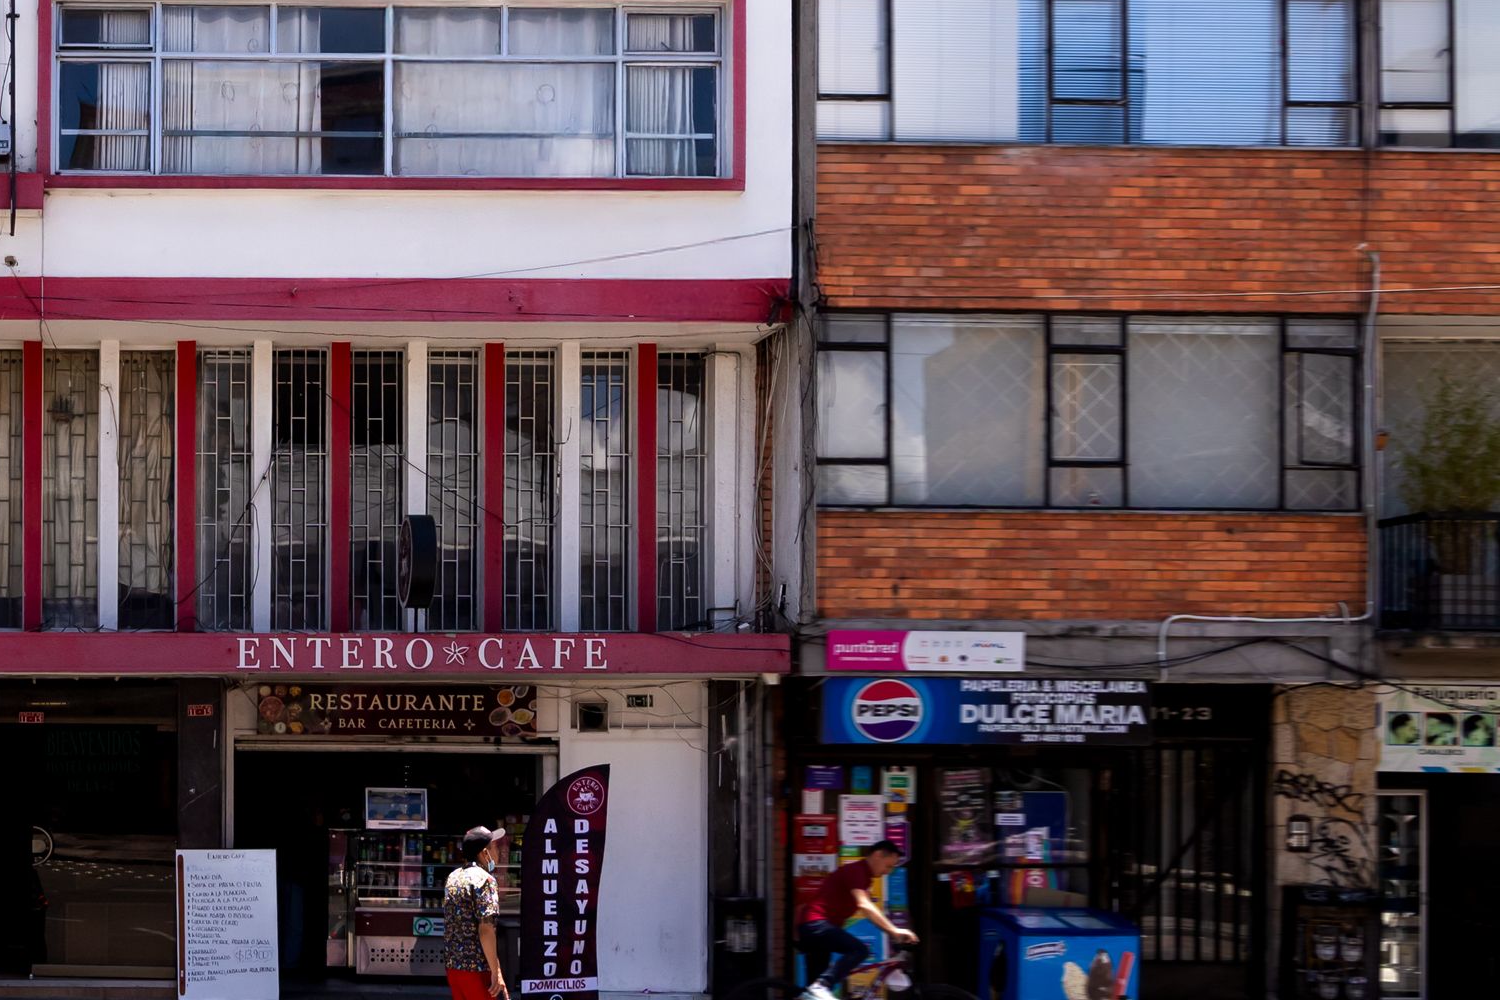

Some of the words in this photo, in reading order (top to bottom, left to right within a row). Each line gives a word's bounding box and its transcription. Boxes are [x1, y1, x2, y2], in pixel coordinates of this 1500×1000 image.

[236, 637, 434, 669] ENTERO
[478, 637, 608, 669] CAFE
[960, 680, 1038, 691] PAPELERIA
[1054, 680, 1148, 692] MISCELANEA
[309, 692, 485, 712] RESTAURANTE
[1010, 693, 1097, 704] FOTOCOPIAS
[857, 703, 920, 717] PEPSI
[959, 704, 1051, 723] DULCE
[1053, 705, 1148, 724] MARIA
[338, 718, 366, 729] BAR
[378, 718, 456, 730] CAFETERIA
[572, 780, 600, 792] ENTERO
[542, 818, 559, 977] ALMUERZO
[570, 819, 590, 975] DESAYUNO
[529, 979, 586, 991] DOMICILIOS
